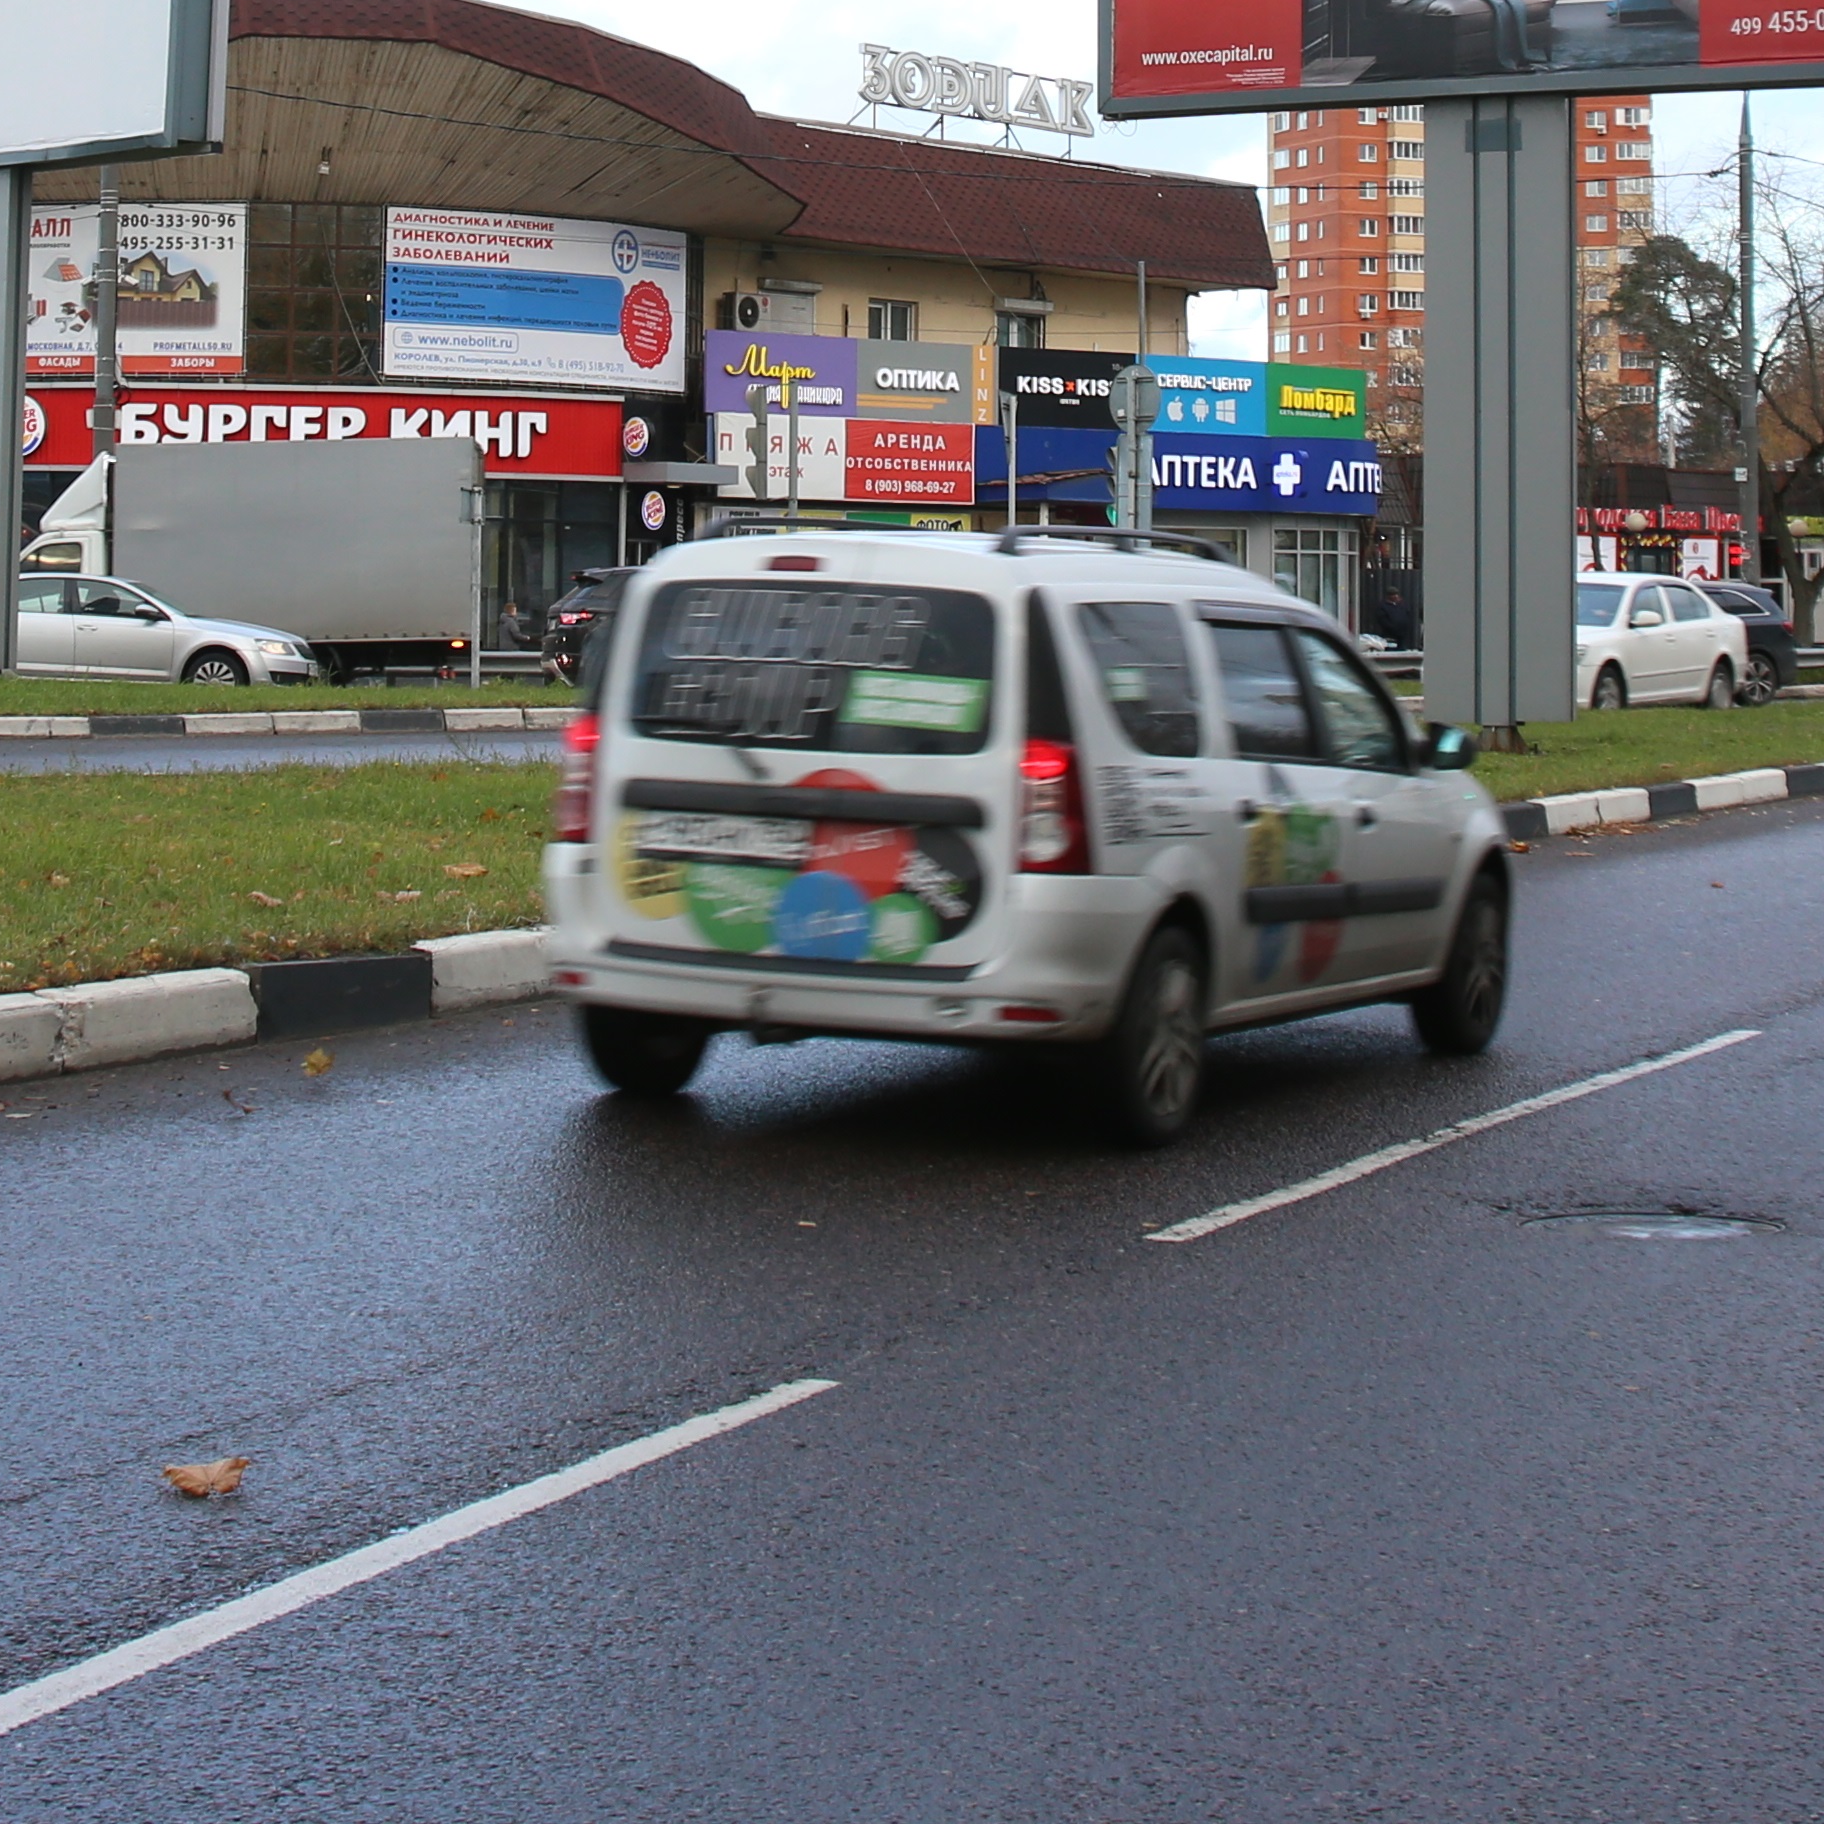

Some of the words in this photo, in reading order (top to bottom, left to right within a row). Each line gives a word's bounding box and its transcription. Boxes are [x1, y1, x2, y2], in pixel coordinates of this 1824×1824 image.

[1730, 17, 1762, 35] 499
[1142, 44, 1273, 66] www.oxecapital.ru
[394, 213, 488, 226] ДИАГНОСТИКА
[494, 218, 502, 227] И
[506, 220, 555, 232] ЛЕЧЕНИЕ
[393, 229, 554, 250] ГИНЕКОЛОГИЧЕСКИХ
[392, 246, 510, 264] ЗАБОЛЕВАНИЙ
[153, 342, 232, 351] PROFMETALL50.RU
[418, 334, 512, 348] www.nebolit.ru
[39, 357, 81, 367] ФАСАДЫ
[171, 359, 215, 368] ЗАБОРЫ
[394, 353, 443, 363] КОРОЛЕВ,
[876, 367, 960, 391] ОПТИКА
[977, 348, 988, 422] LINZ
[1017, 376, 1065, 394] KISS
[1077, 379, 1113, 397] KIS
[797, 385, 842, 405] АНИКЮРА
[1280, 385, 1356, 419] Ломбард
[121, 403, 367, 444] БУРГЕР
[389, 408, 547, 459] КИНГ
[874, 432, 946, 452] АРЕНДА
[865, 479, 872, 491] 8
[875, 479, 902, 495] (903)
[904, 480, 956, 493] 968-69-27
